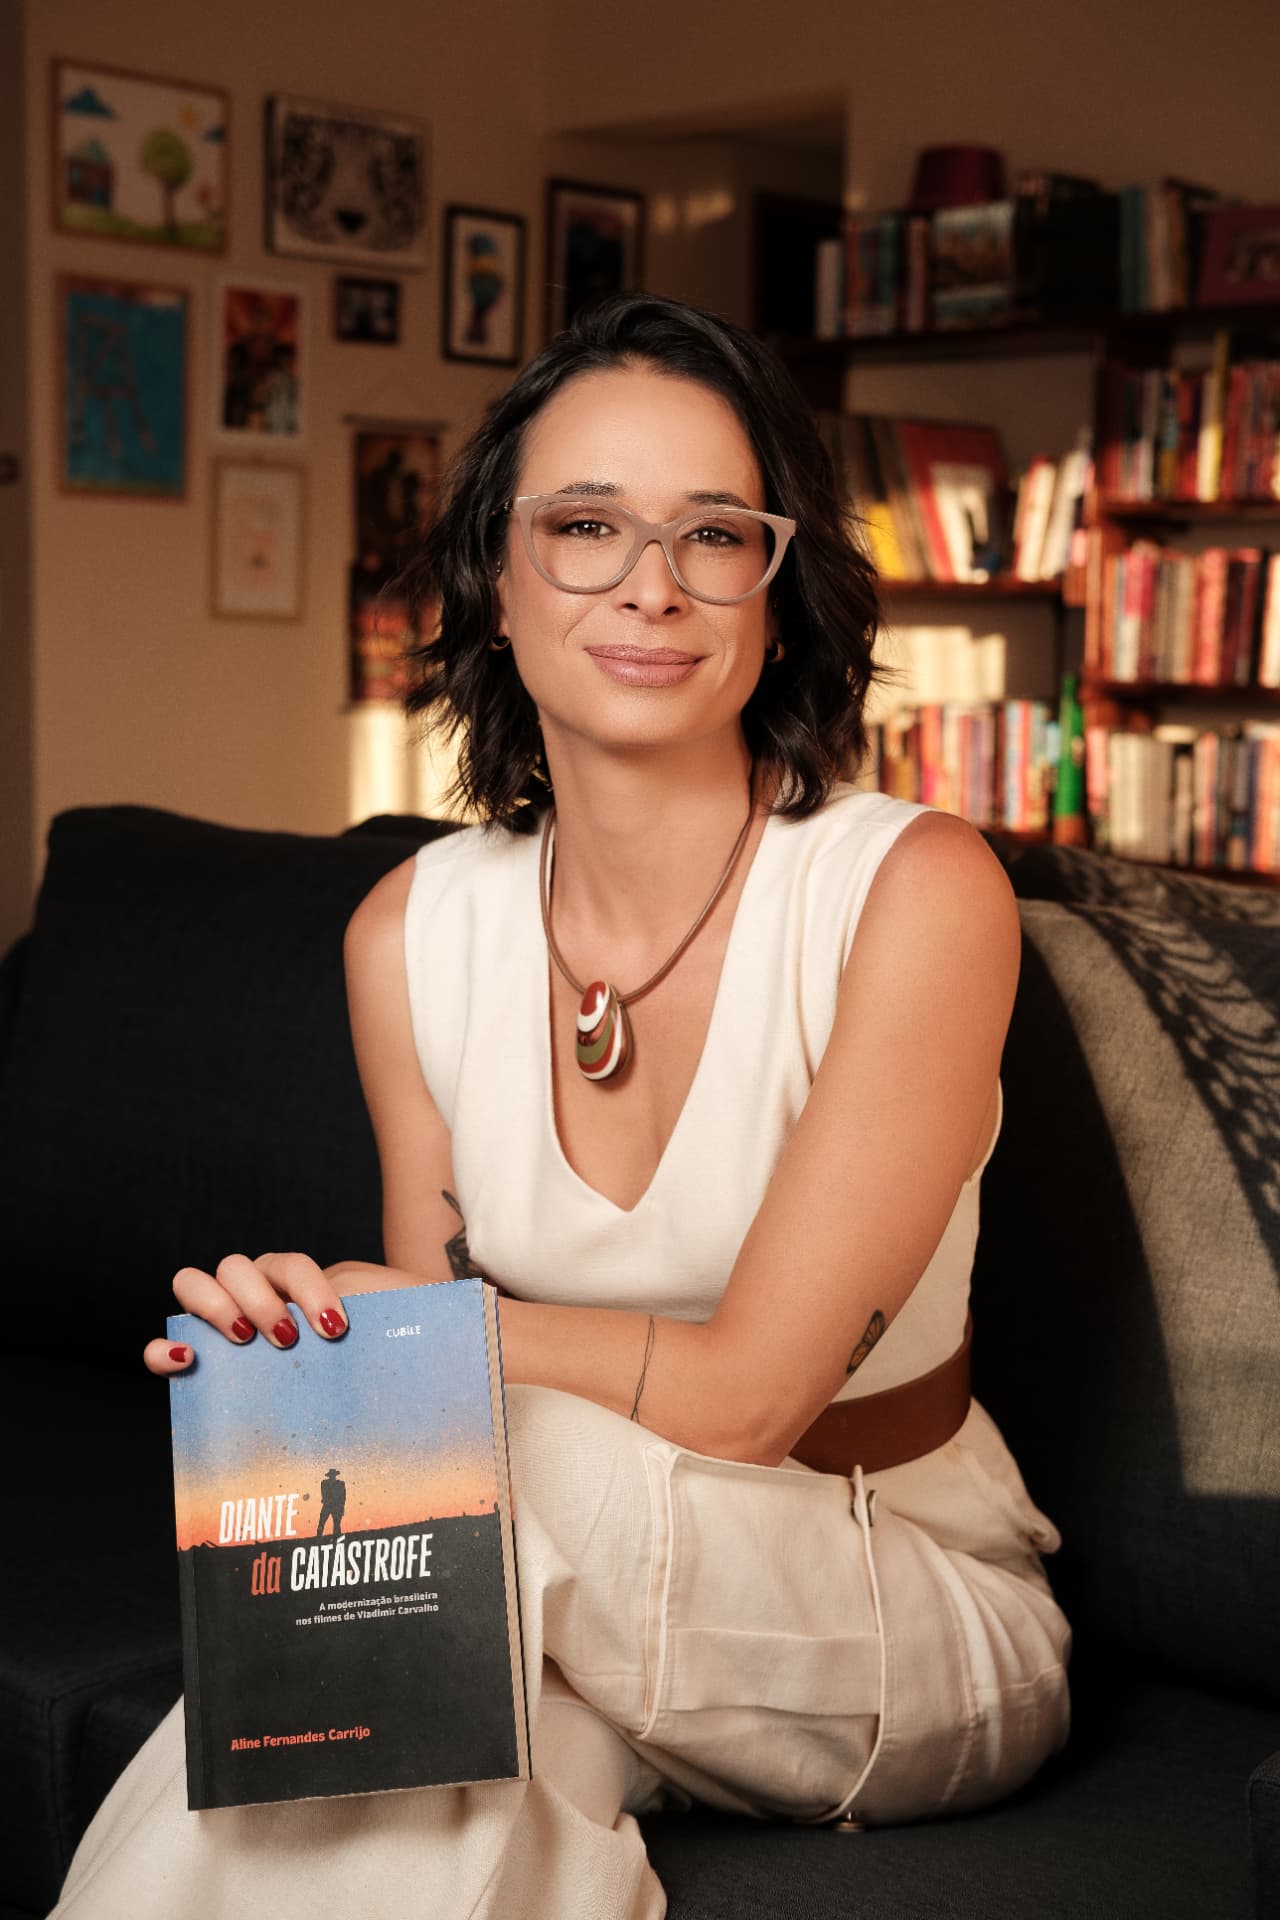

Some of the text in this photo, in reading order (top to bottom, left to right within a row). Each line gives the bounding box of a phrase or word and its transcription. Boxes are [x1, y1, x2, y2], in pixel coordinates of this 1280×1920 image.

[219, 1493, 300, 1544] DIANTE
[251, 1533, 434, 1596] da CATÁSTROFE
[295, 1603, 439, 1626] nos filmes de Vladimir Carvalho
[319, 1591, 438, 1611] A modernização brasileira
[231, 1724, 371, 1751] Aline Fernandes Carrijo
